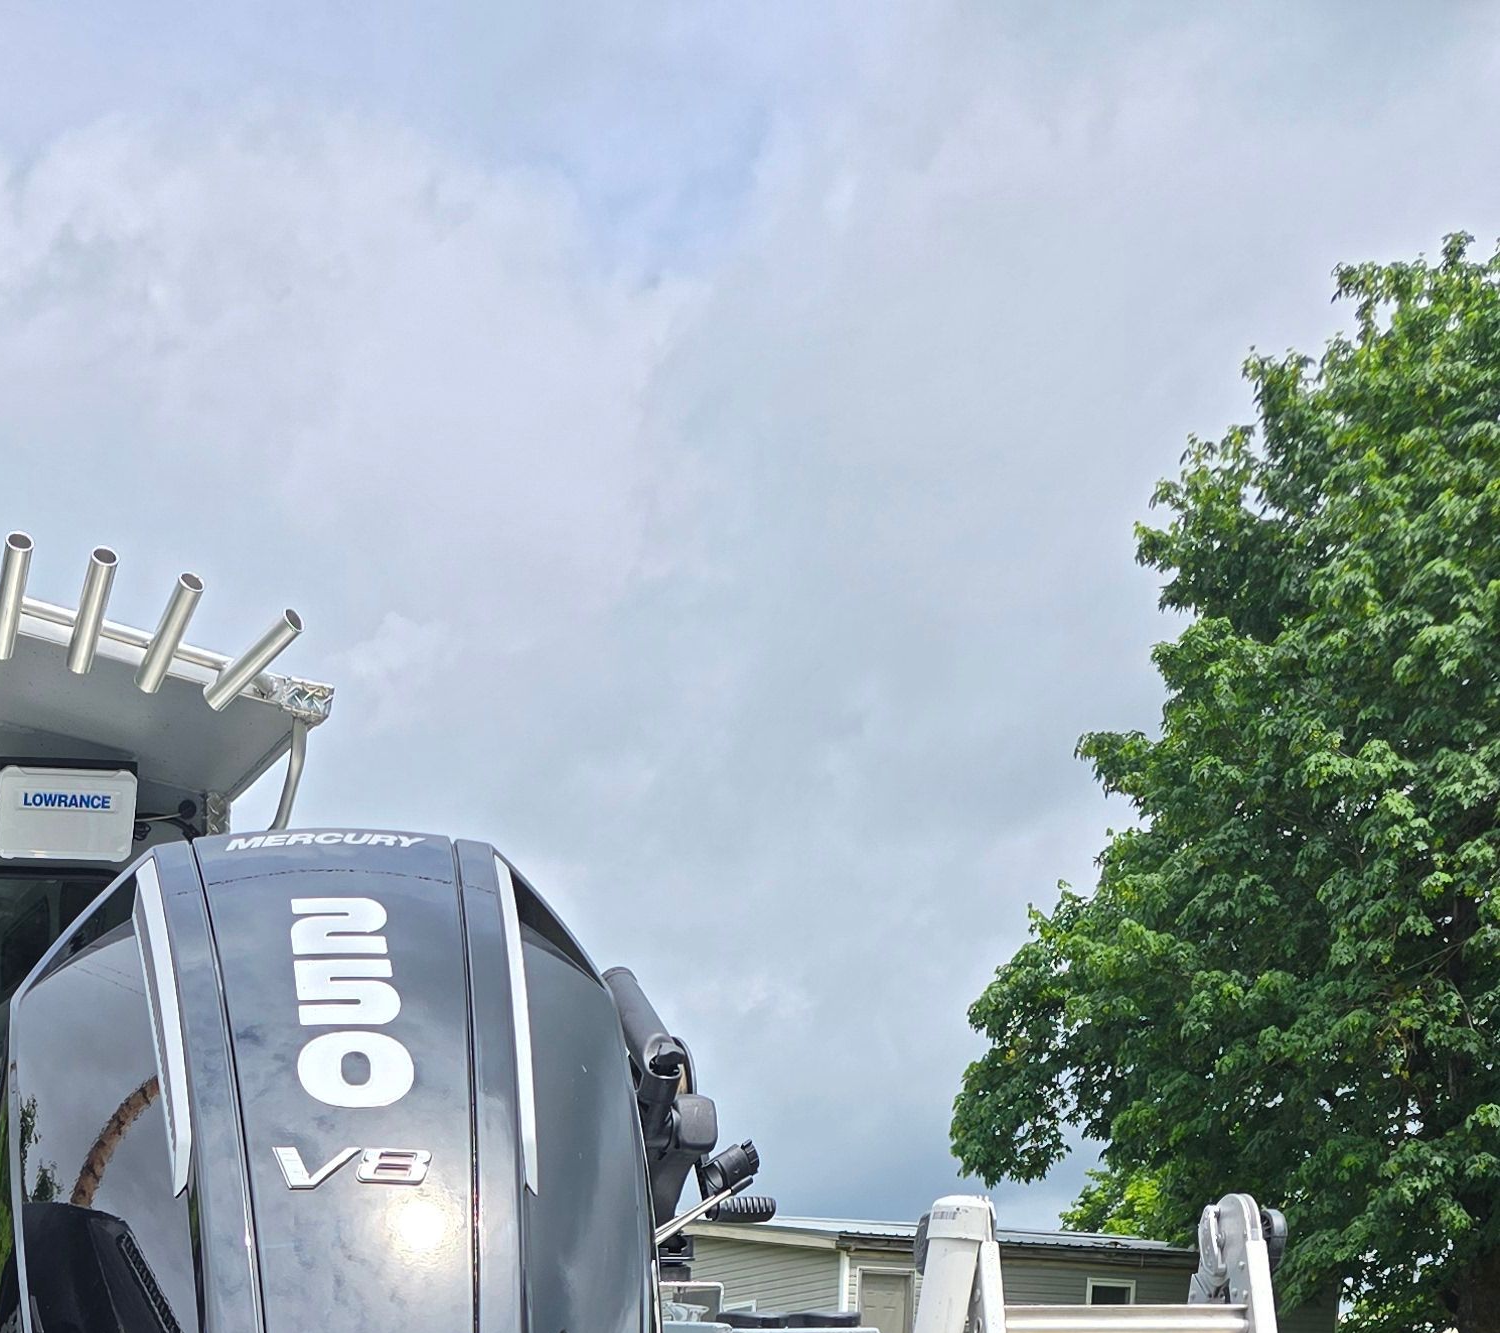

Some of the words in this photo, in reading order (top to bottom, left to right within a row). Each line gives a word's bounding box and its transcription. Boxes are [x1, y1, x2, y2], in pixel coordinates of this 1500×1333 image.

[23, 791, 112, 810] LOWRANCE
[224, 832, 427, 852] MERCURY
[290, 897, 414, 1109] 250
[272, 1147, 432, 1191] V8
